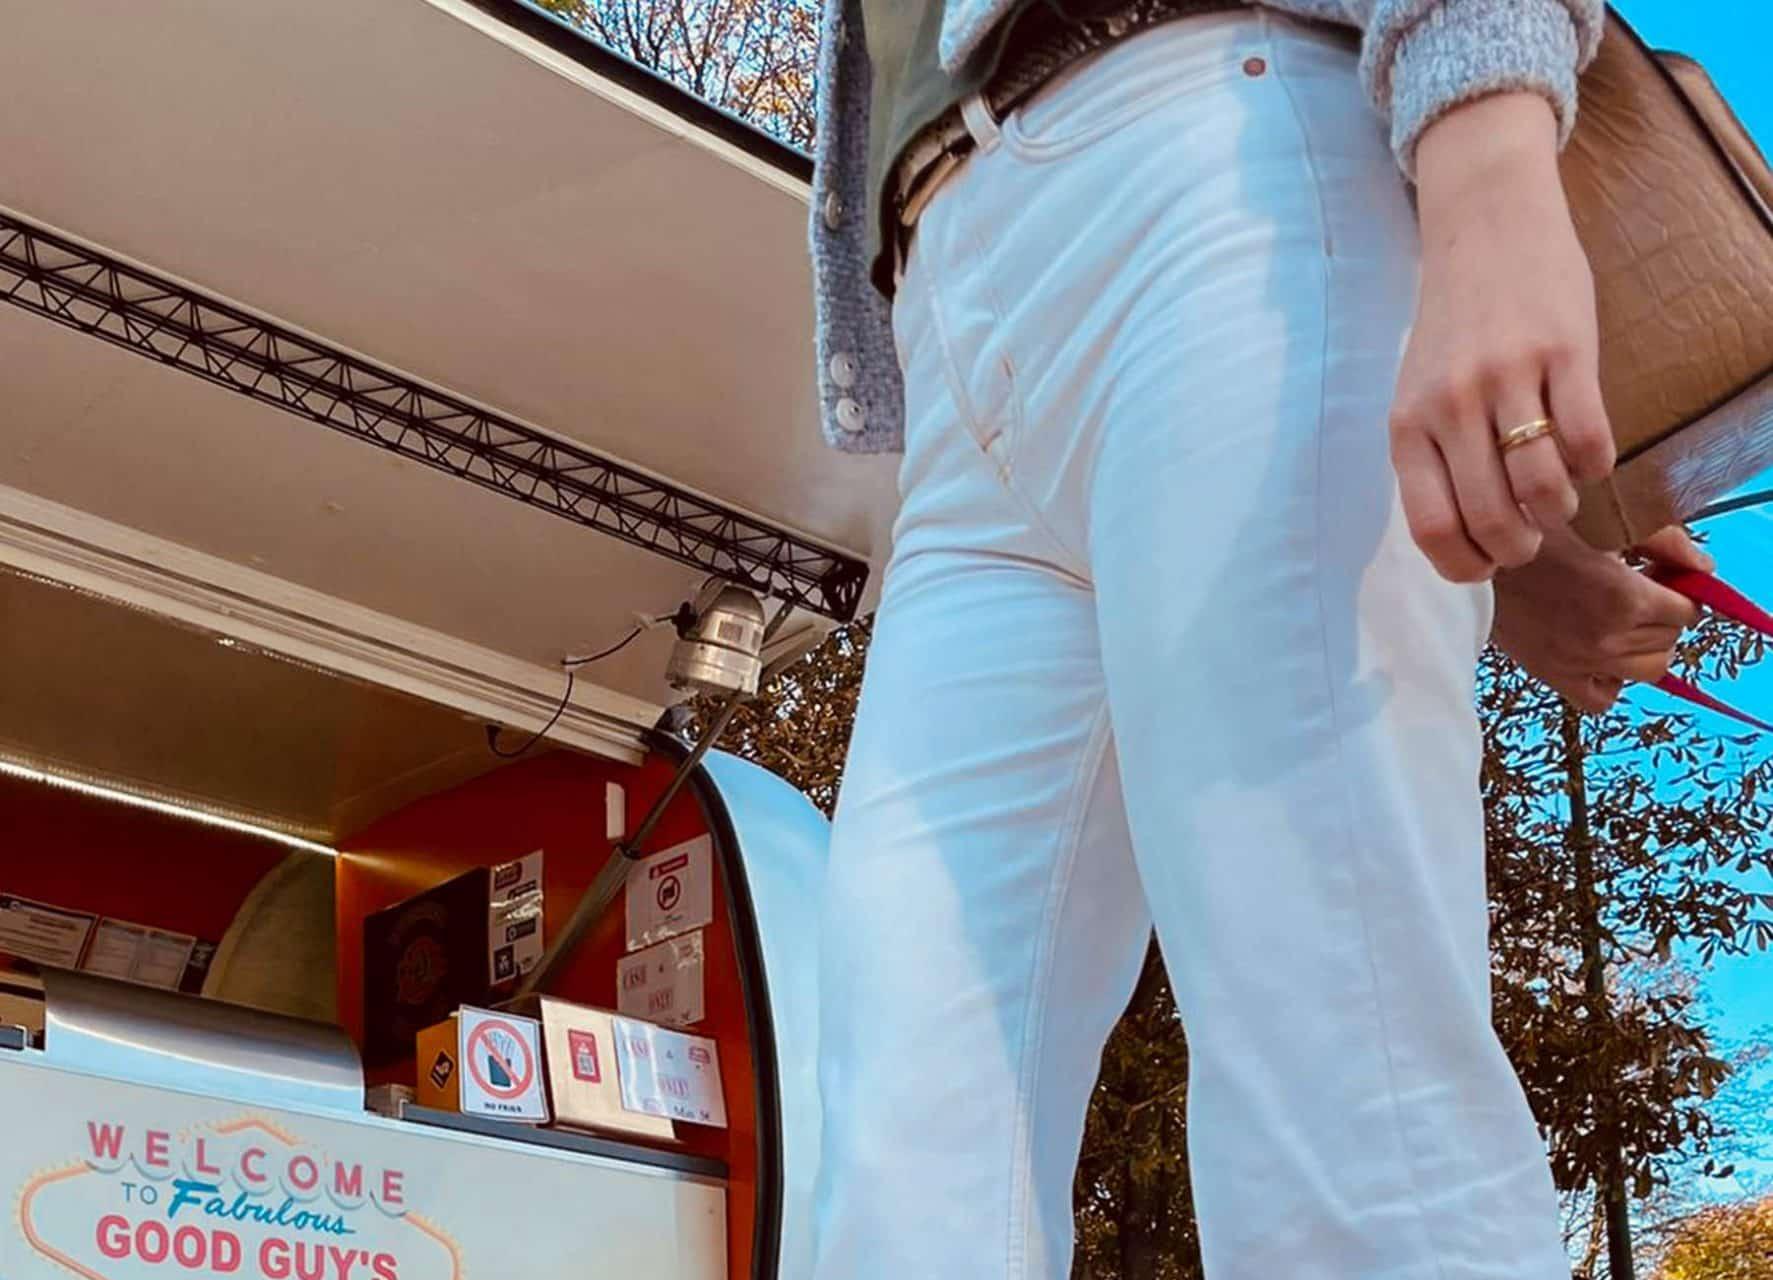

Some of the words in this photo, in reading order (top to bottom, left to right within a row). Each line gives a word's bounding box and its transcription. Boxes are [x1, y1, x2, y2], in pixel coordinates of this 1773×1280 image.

[87, 1121, 404, 1204] WELCOME
[120, 1181, 158, 1206] TO
[168, 1178, 356, 1235] Fabulous
[95, 1214, 241, 1273] GOOD
